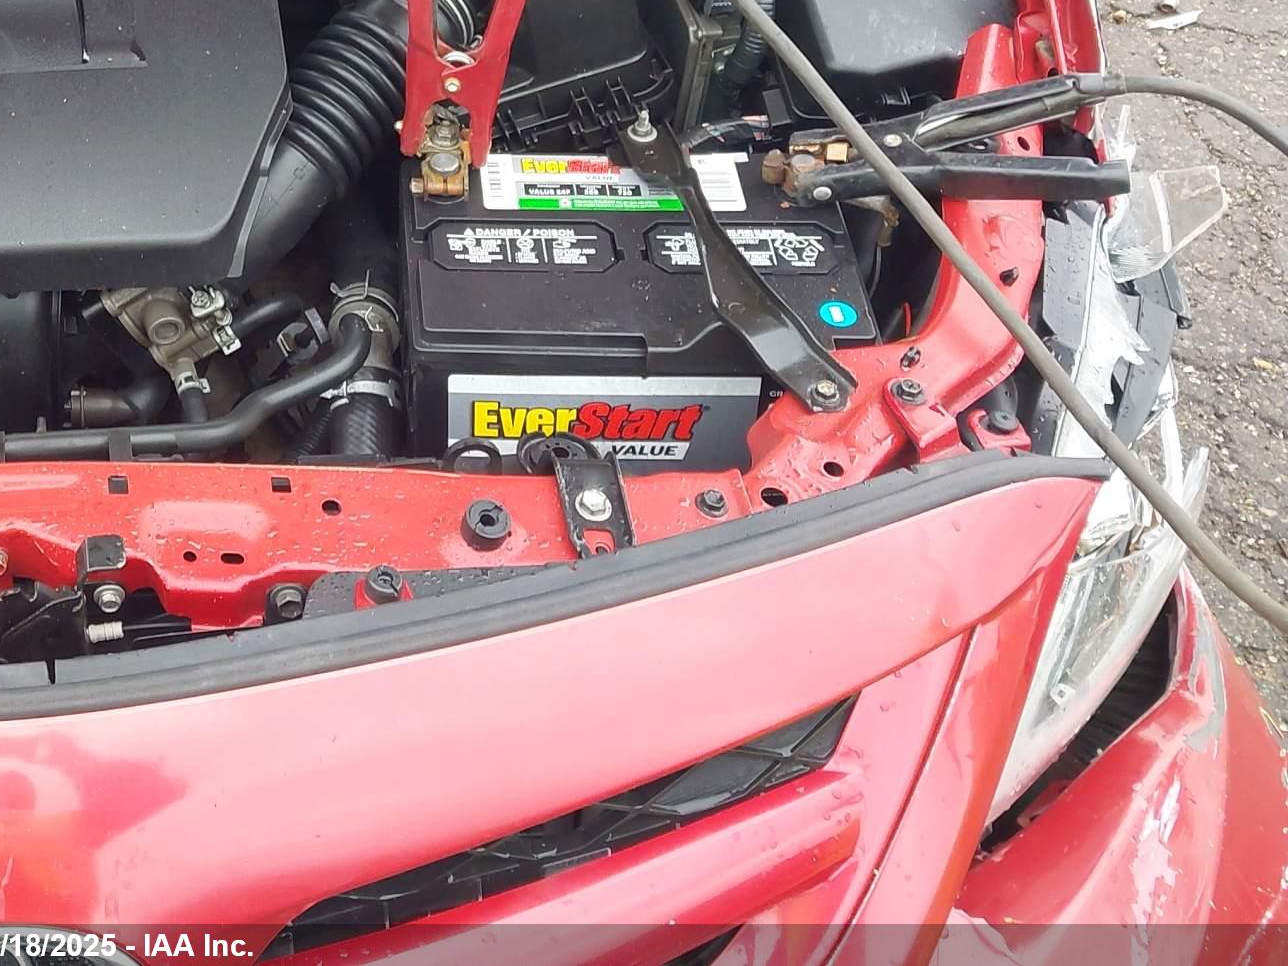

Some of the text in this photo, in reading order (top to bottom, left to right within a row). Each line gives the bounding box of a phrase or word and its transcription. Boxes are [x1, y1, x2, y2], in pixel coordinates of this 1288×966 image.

[475, 228, 521, 237] DANGER
[533, 228, 575, 237] POISON
[472, 400, 704, 440] EverStart
[612, 444, 677, 458] VALUE
